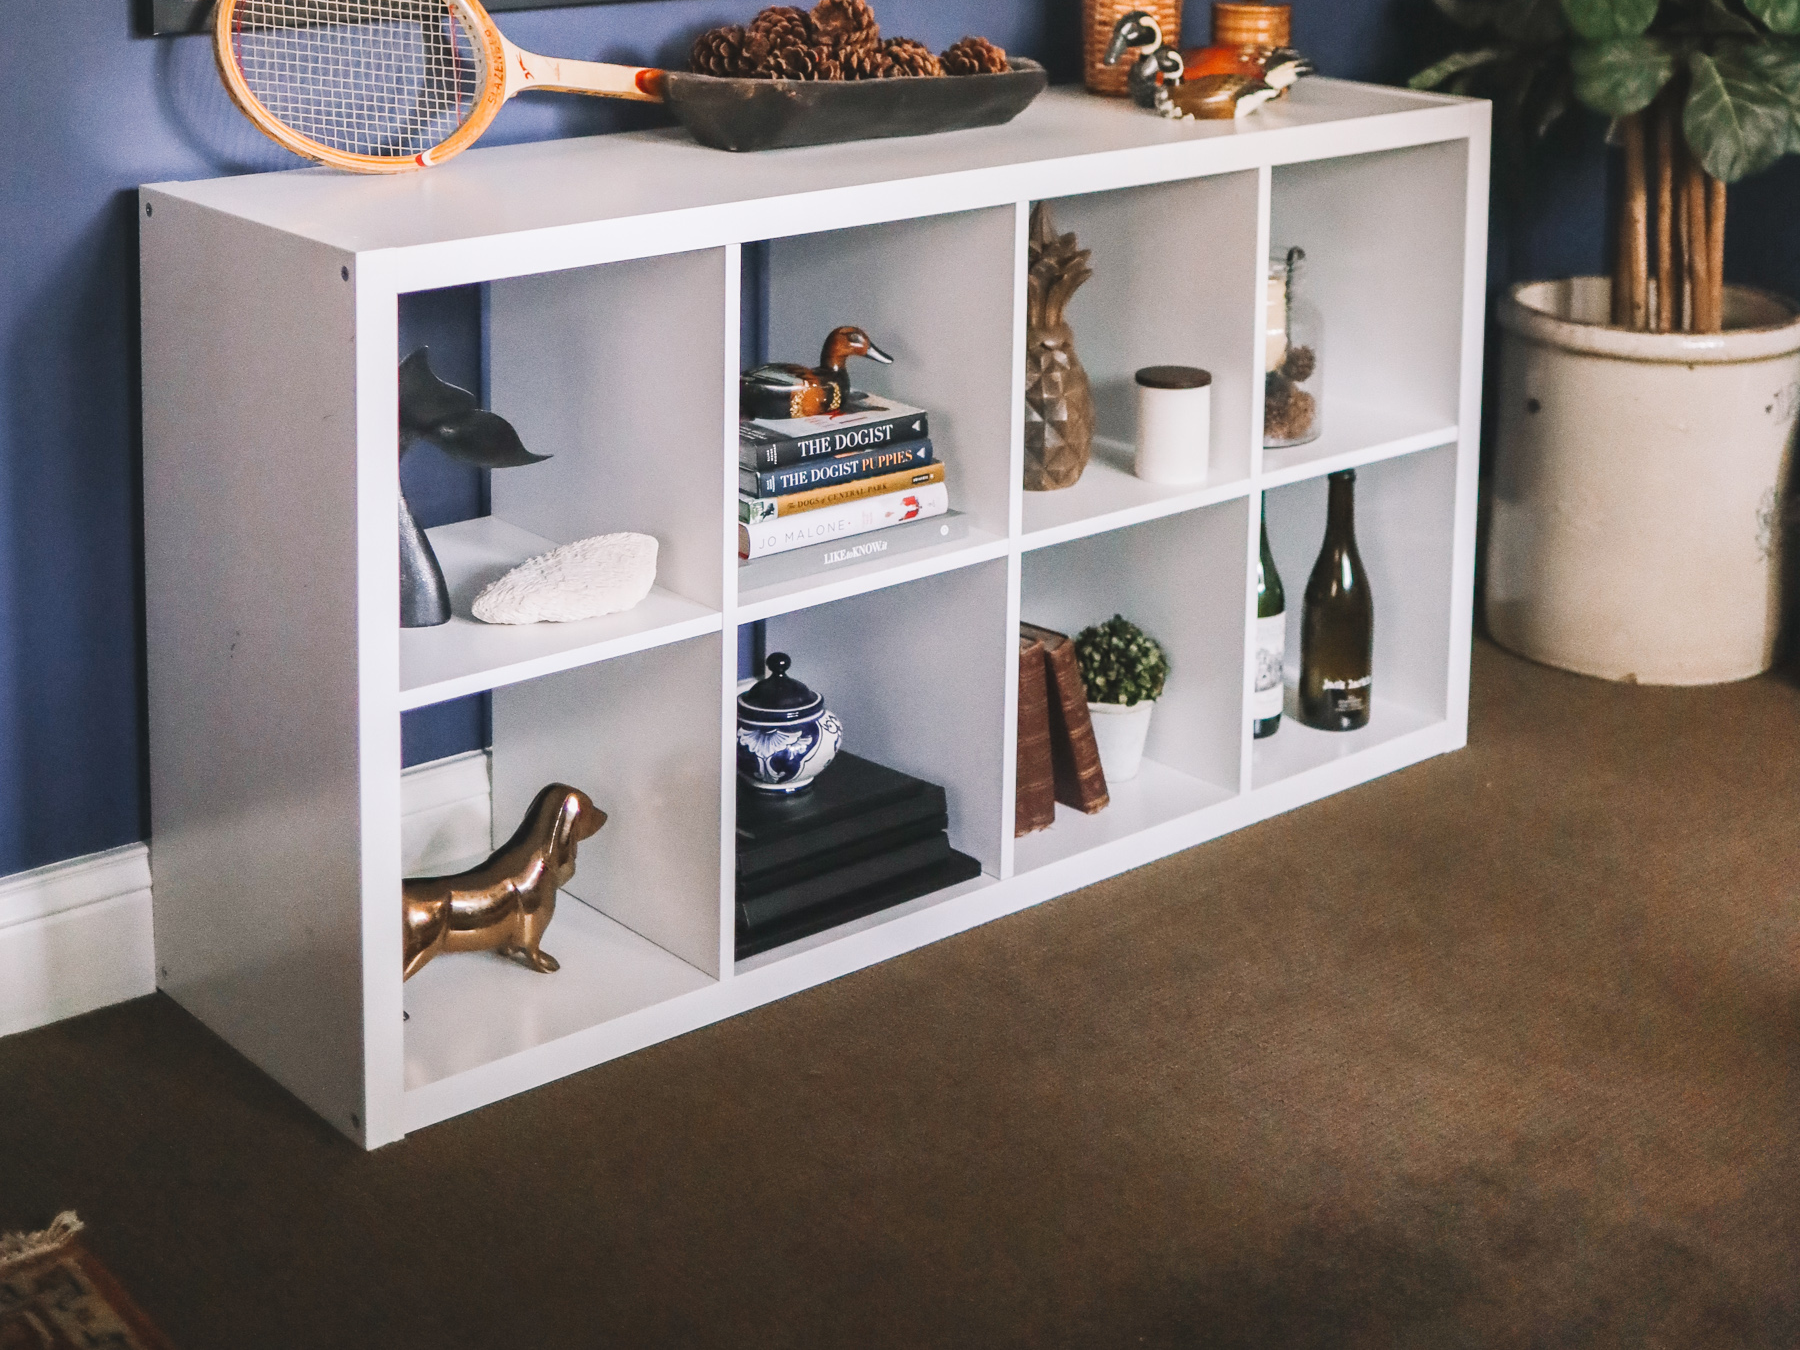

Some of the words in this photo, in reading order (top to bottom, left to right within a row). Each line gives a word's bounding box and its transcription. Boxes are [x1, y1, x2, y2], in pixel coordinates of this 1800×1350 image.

[798, 436, 832, 458] THE
[835, 424, 894, 451] DOGIST
[780, 471, 808, 489] THE
[811, 460, 860, 483] DOGIST
[862, 449, 914, 472] PUPPIES
[797, 497, 820, 508] DOGS
[828, 488, 865, 503] CENTRAL
[867, 482, 888, 494] PARK
[758, 535, 777, 550] JO
[784, 519, 845, 543] MALONE
